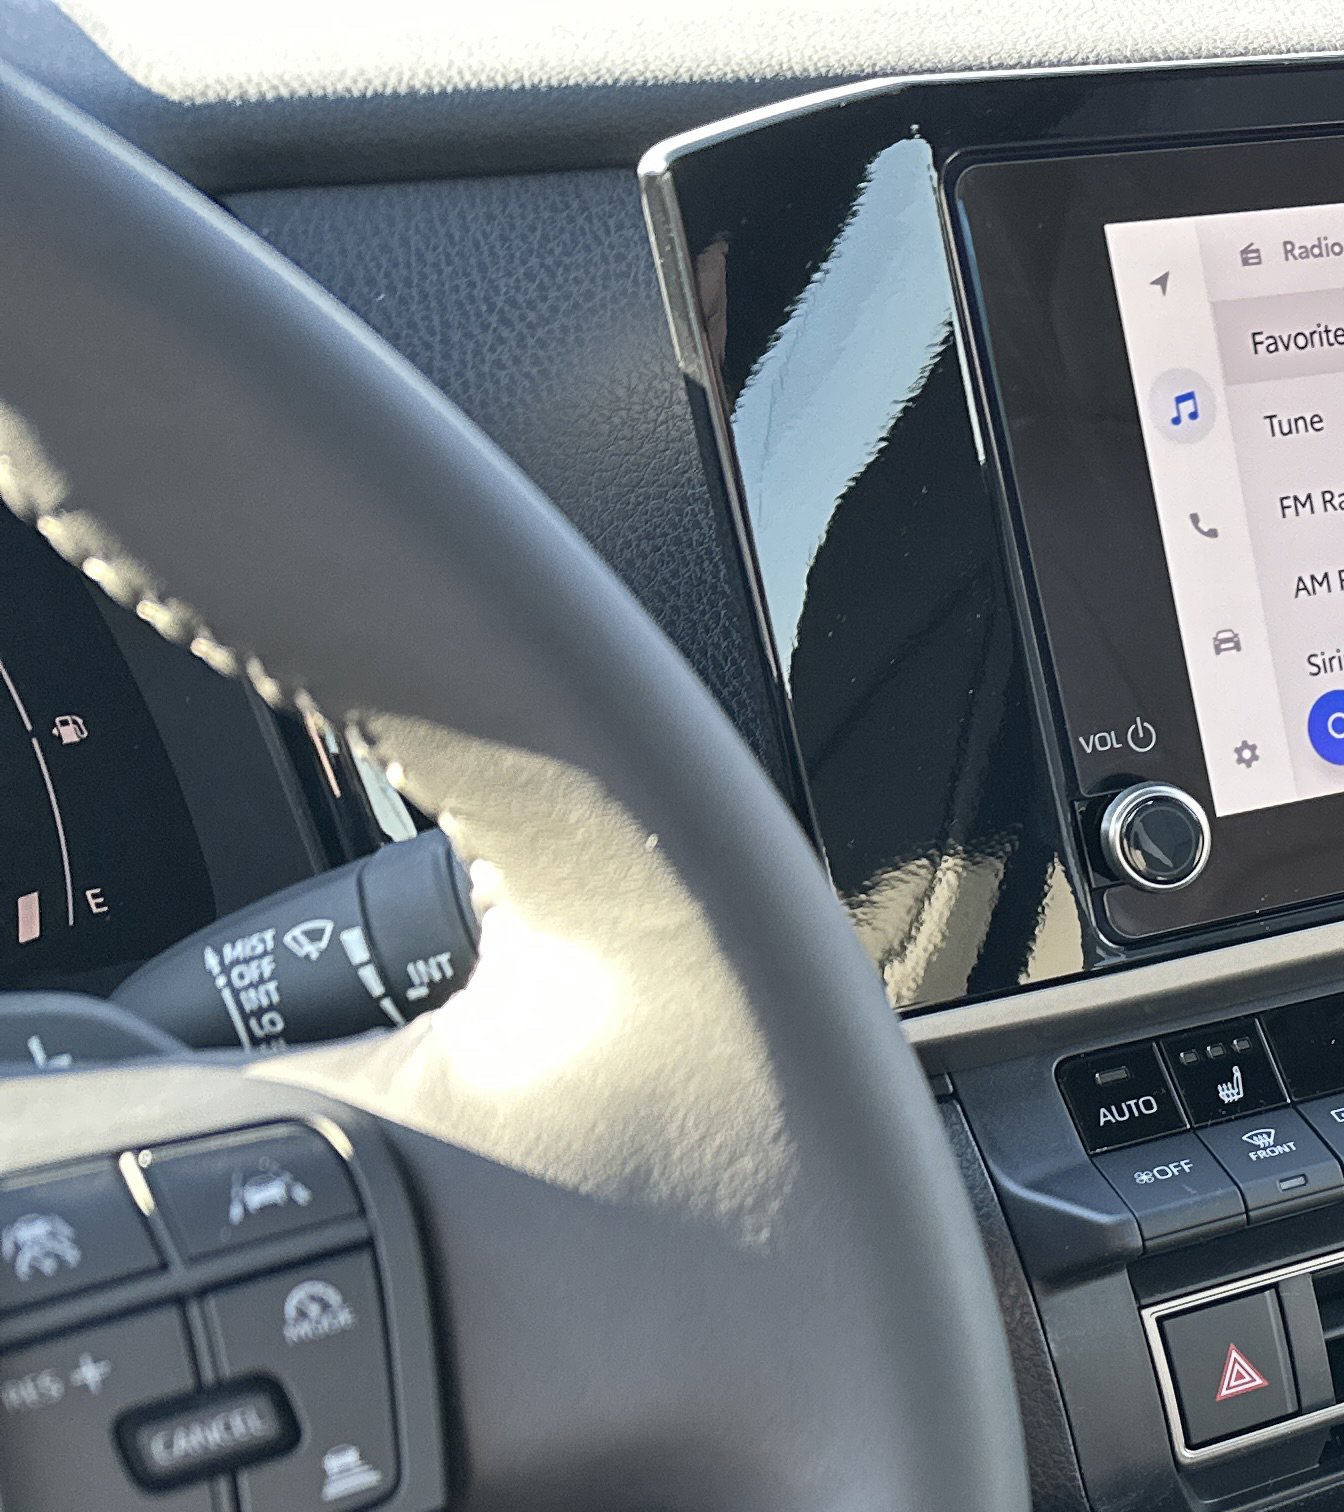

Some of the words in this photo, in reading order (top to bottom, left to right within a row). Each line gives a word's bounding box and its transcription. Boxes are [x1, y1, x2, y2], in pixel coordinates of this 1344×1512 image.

[1282, 236, 1344, 262] Radio
[1264, 411, 1325, 438] Tune
[1279, 494, 1316, 519] FM
[1293, 572, 1333, 599] AM
[1079, 729, 1123, 755] VOL
[84, 887, 110, 915] E
[222, 928, 277, 966] MIST
[230, 954, 277, 989] OFF
[238, 980, 281, 1014] INT
[250, 1011, 285, 1039] LO
[1098, 1095, 1158, 1127] AUTO
[1248, 1141, 1297, 1162] FRONT
[1151, 1159, 1194, 1182] OFF
[150, 1403, 267, 1466] CANCEL
